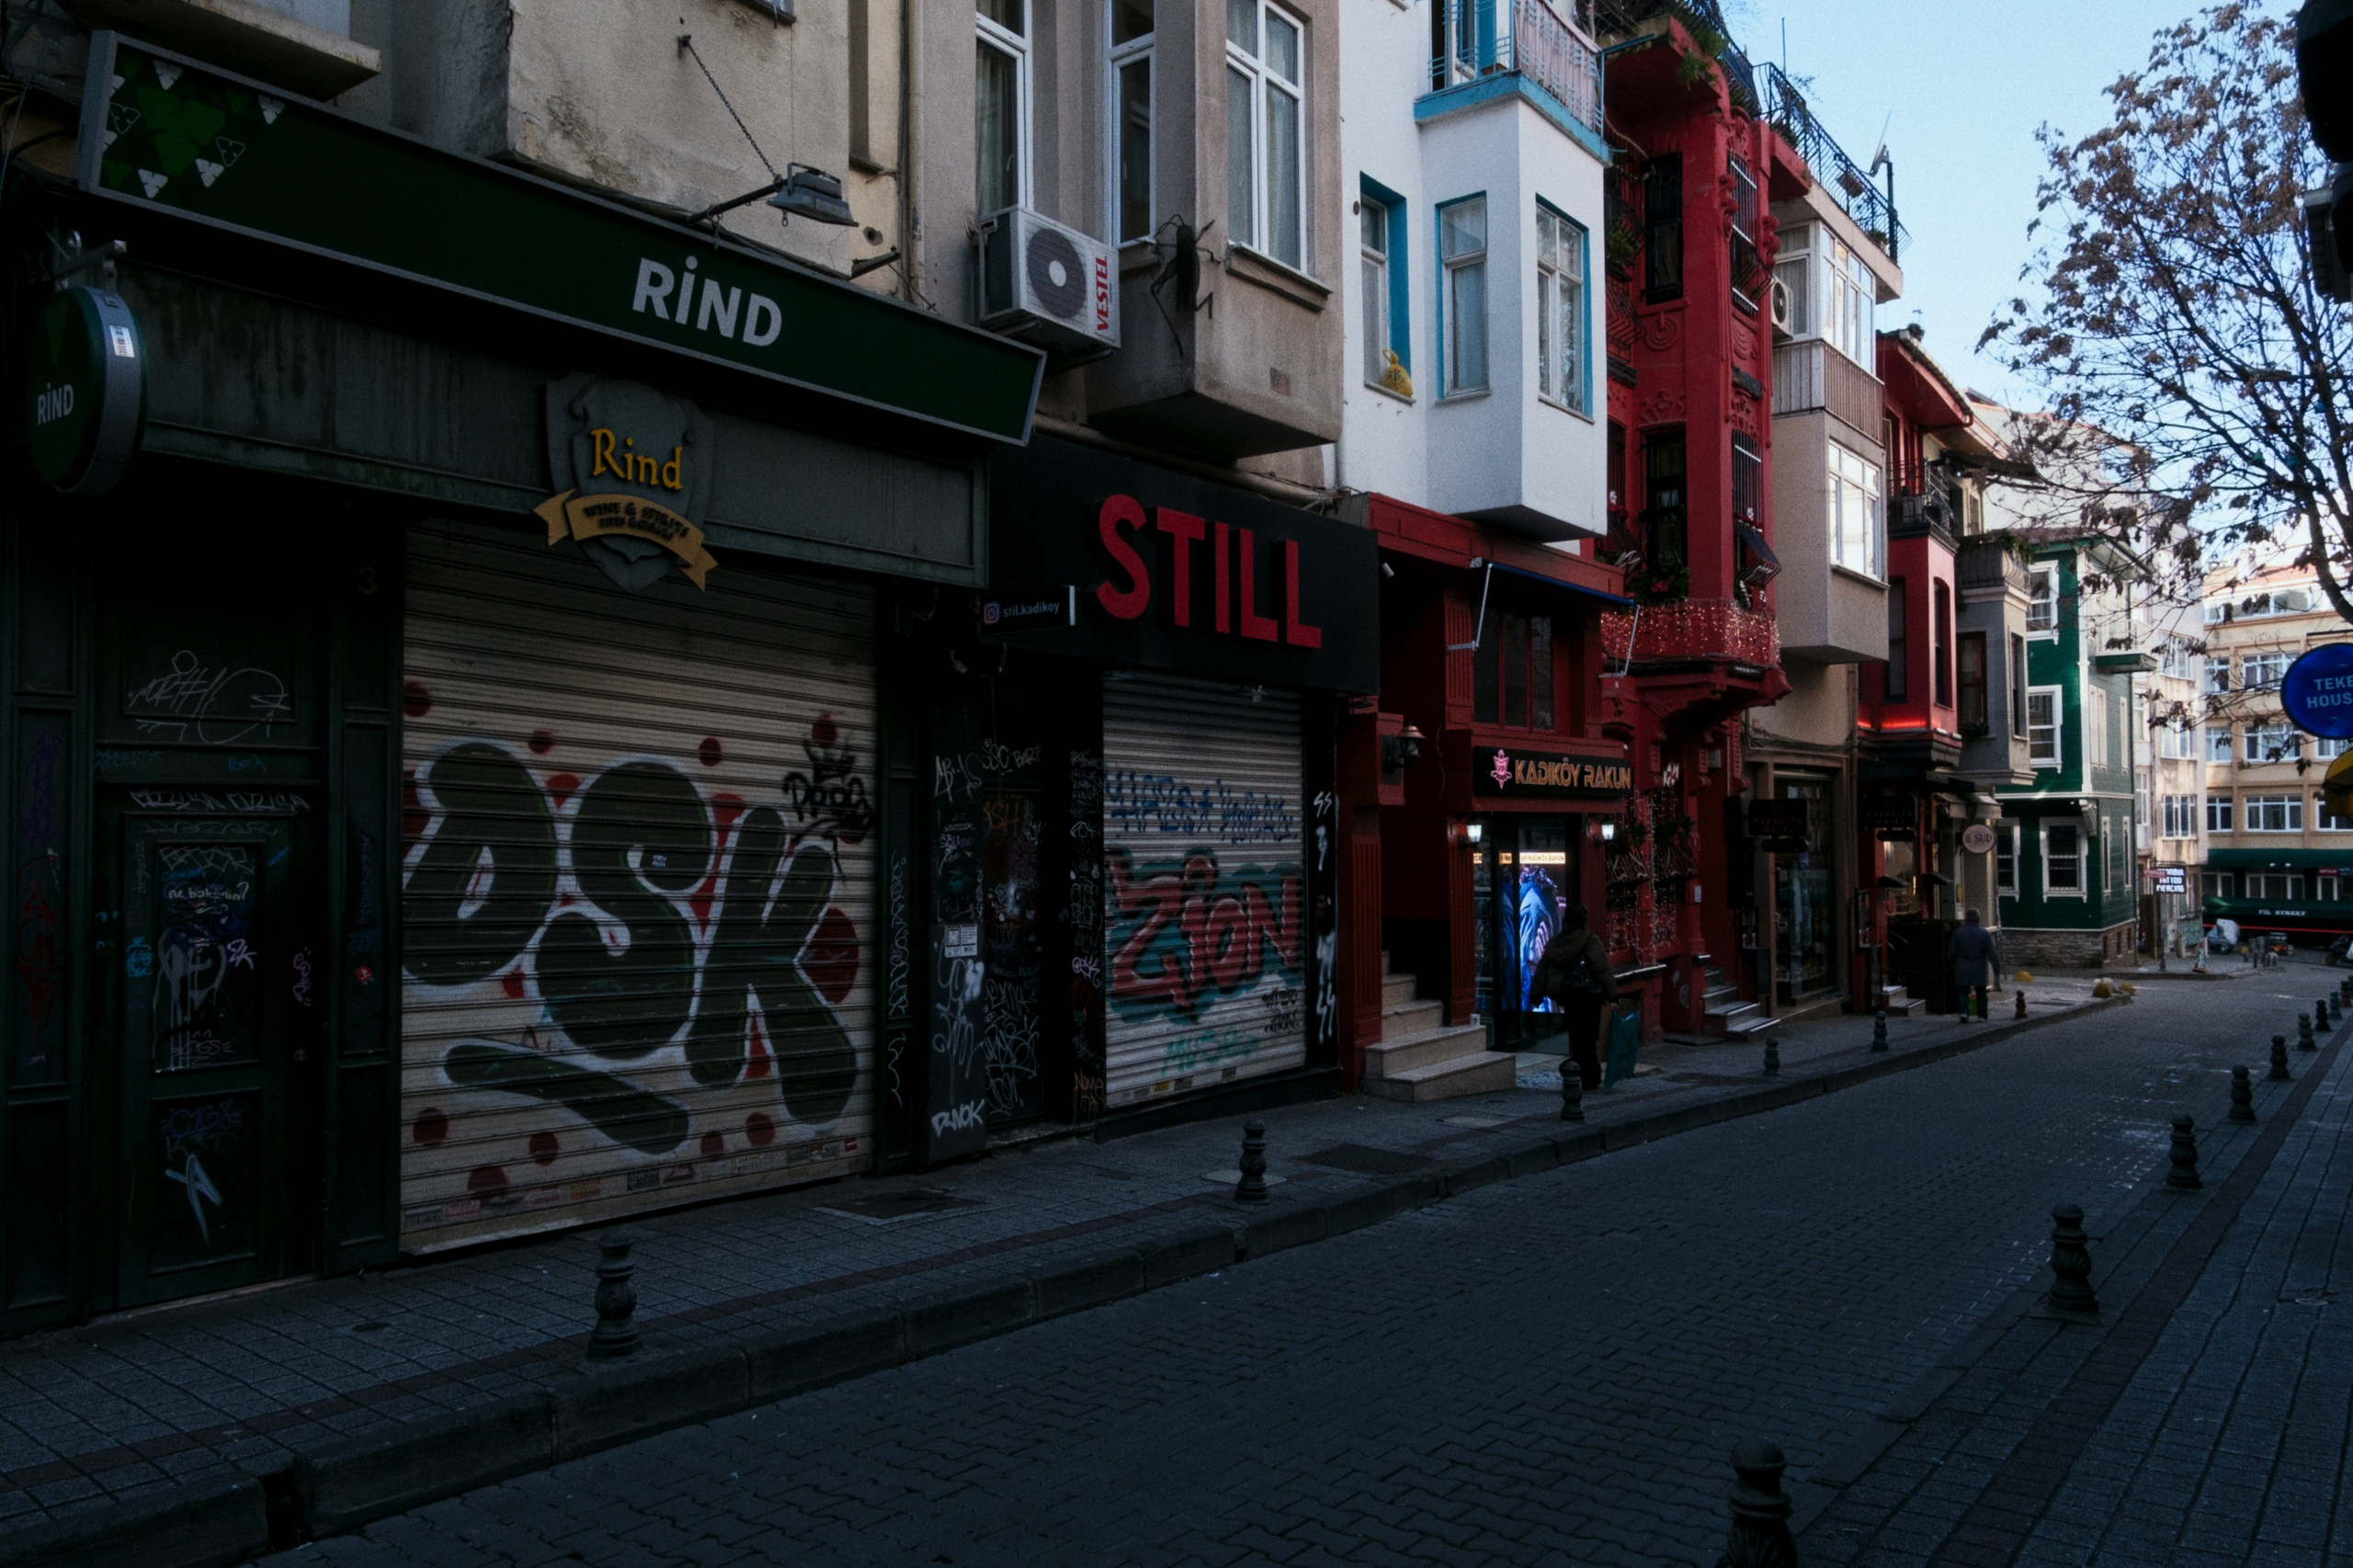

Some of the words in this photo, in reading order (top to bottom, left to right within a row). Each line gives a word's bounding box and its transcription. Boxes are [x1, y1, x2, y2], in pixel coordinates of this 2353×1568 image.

[631, 255, 783, 347] RİND
[1095, 256, 1108, 331] VESTEL
[37, 381, 74, 426] RİND
[590, 427, 684, 491] Rind
[583, 502, 621, 517] WINE
[625, 502, 637, 516] &
[642, 506, 689, 538] SPIRITS
[357, 565, 379, 596] 3
[1096, 494, 1323, 650] STILL
[1003, 600, 1061, 619] stil.kadikoy
[2306, 692, 2353, 709] HOUS
[1514, 756, 1582, 788] KADIKÖY
[1584, 764, 1631, 790] RAKUN
[1974, 834, 1993, 844] SUD
